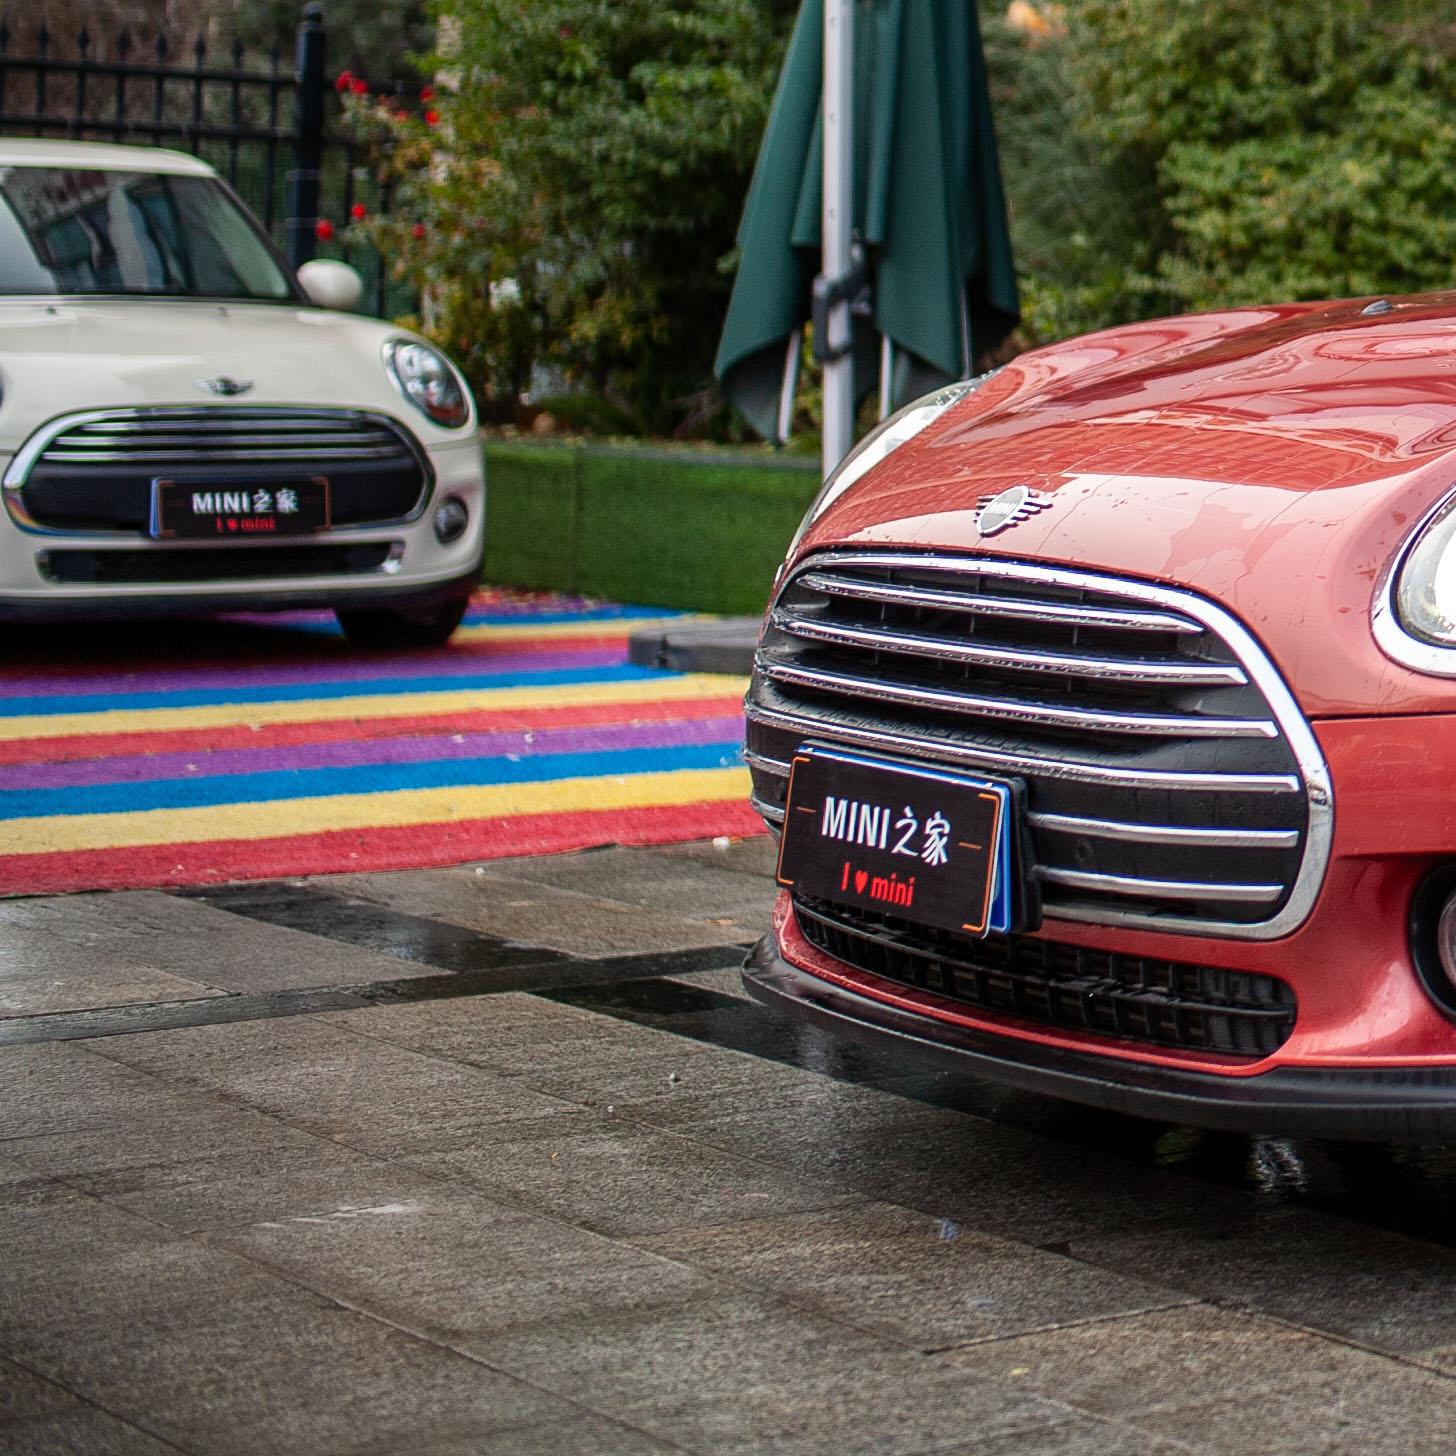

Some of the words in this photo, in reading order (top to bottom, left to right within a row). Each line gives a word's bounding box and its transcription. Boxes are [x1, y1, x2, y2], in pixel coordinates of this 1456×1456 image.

[821, 795, 950, 866] MINI之家
[840, 861, 850, 892] I
[870, 872, 916, 908] mini
